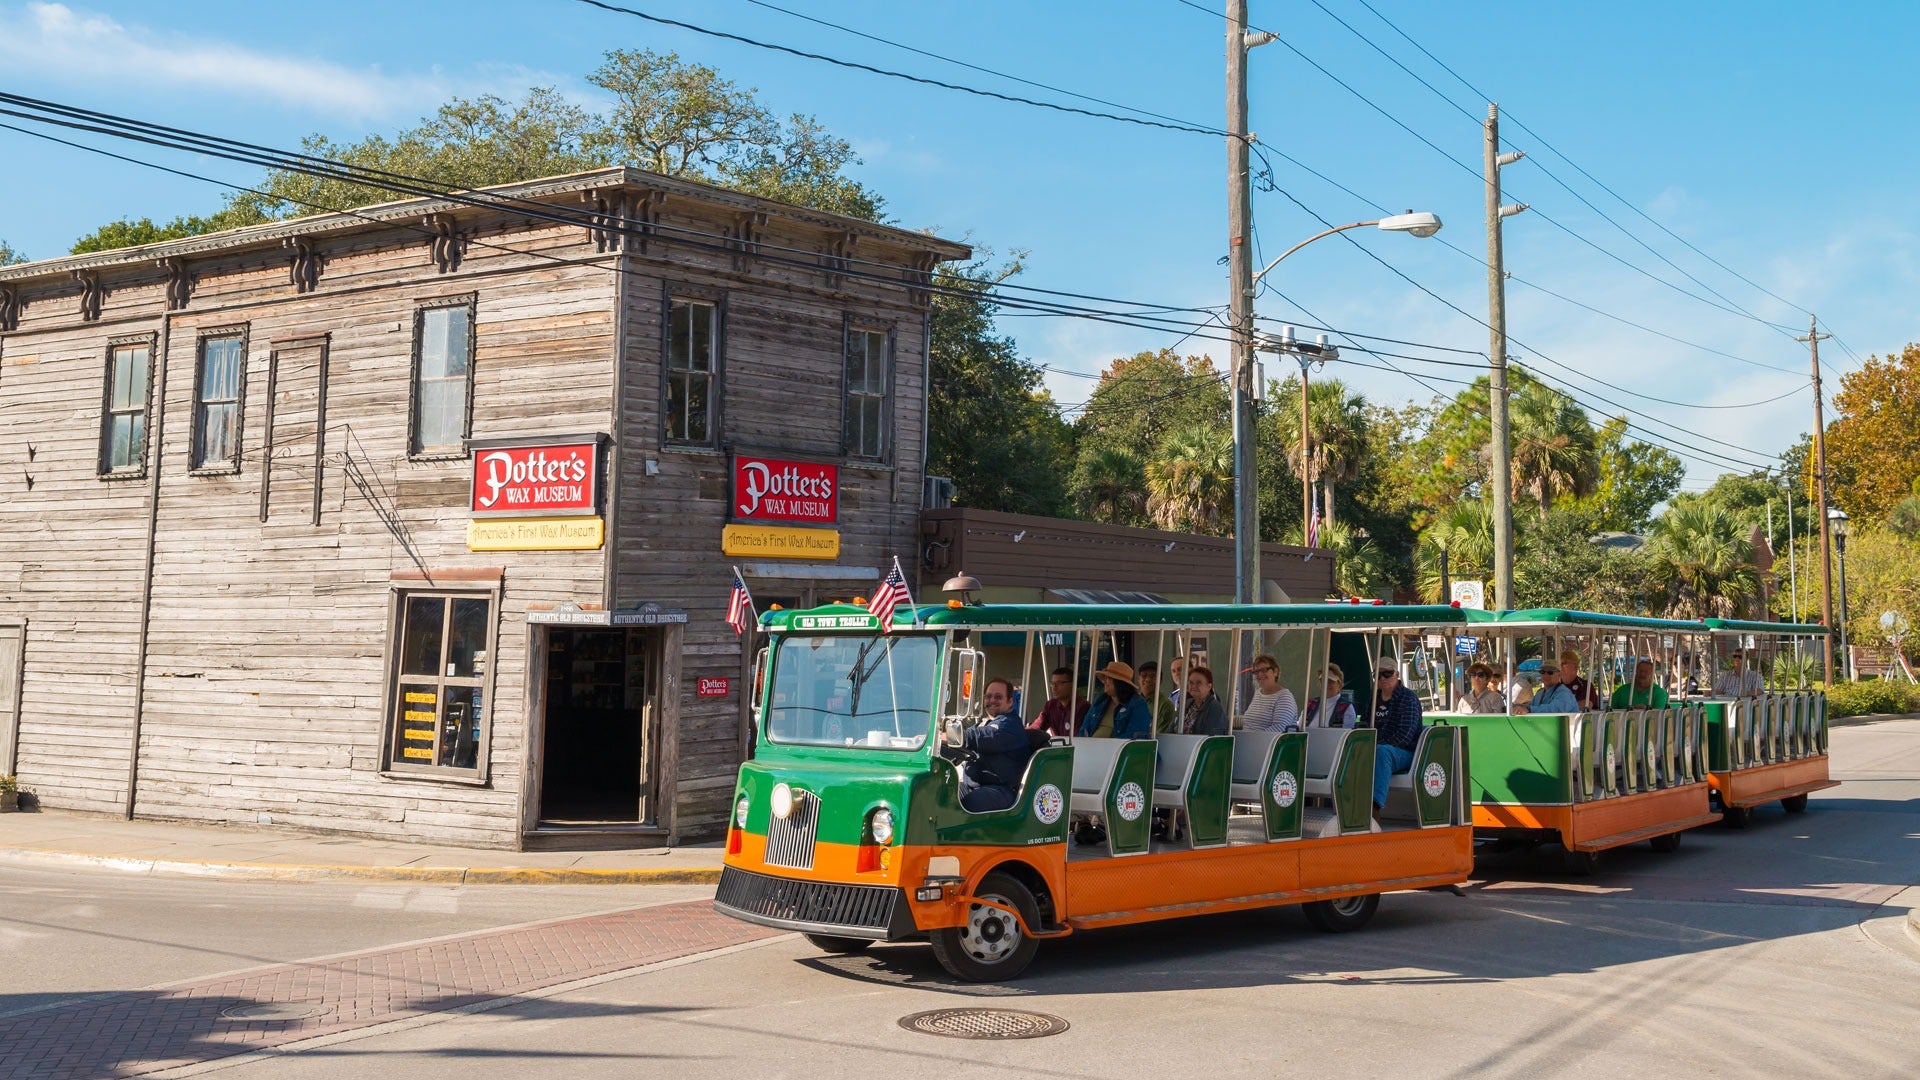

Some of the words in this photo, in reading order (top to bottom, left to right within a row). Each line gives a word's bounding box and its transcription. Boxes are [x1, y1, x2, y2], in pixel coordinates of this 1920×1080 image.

[479, 451, 586, 507] Potter's
[506, 487, 530, 503] WAX
[534, 485, 582, 503] MUSEUM
[740, 461, 832, 515] Potter's
[765, 498, 786, 514] WAX
[790, 500, 829, 517] MUSEUM
[472, 525, 515, 541] America's
[518, 525, 537, 539] First
[540, 525, 558, 538] Wax
[560, 524, 596, 538] Museum
[729, 532, 767, 547] America's
[769, 533, 787, 545] First
[788, 534, 804, 548] Wax
[805, 535, 834, 549] Museum
[802, 618, 815, 627] OLD
[817, 617, 837, 627] TOWN
[839, 617, 870, 627] TROLLEY
[1045, 633, 1063, 645] ATM
[700, 679, 727, 694] Potter's
[926, 746, 931, 756] 7
